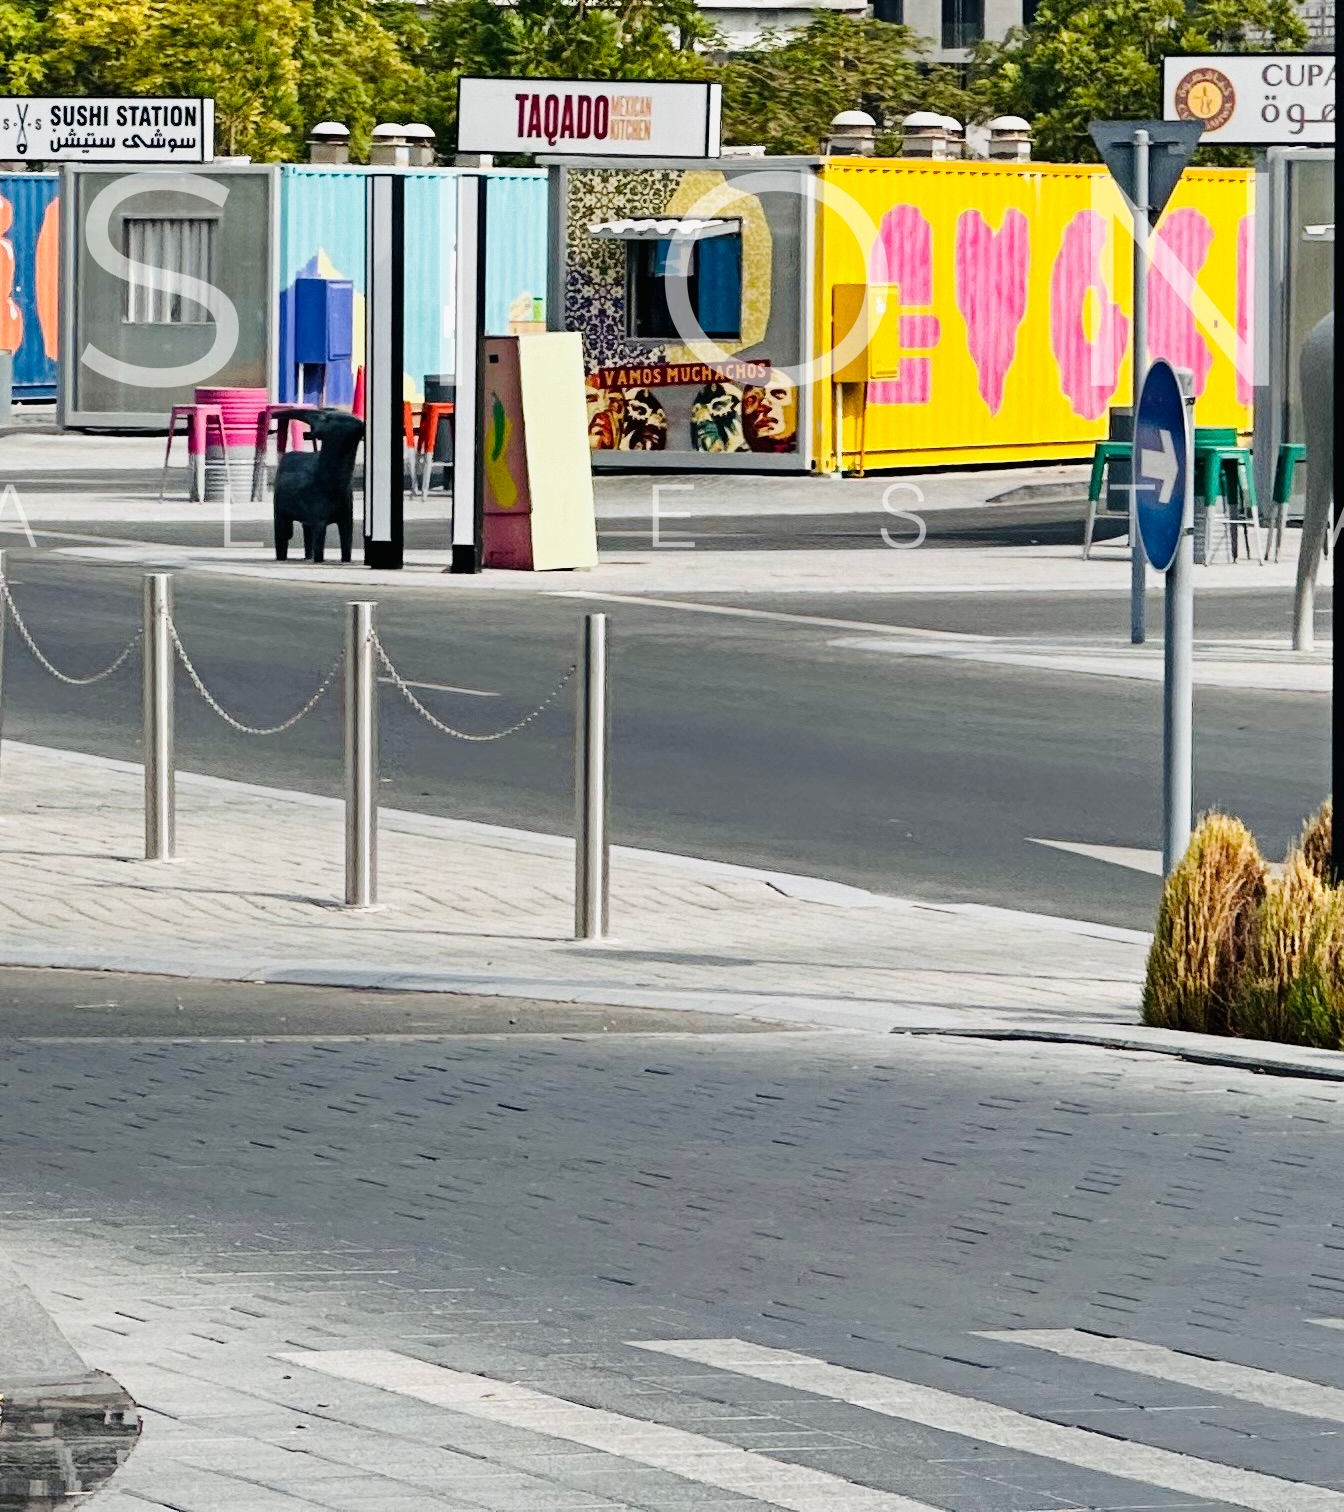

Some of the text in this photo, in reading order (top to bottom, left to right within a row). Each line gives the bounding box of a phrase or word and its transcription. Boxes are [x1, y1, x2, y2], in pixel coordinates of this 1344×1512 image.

[50, 106, 197, 127] SUSHI STATION
[515, 93, 653, 147] TAQADO MEXICAN
[610, 119, 652, 141] KITCHEN
[605, 363, 767, 386] VAMOS MUCHACHOS
